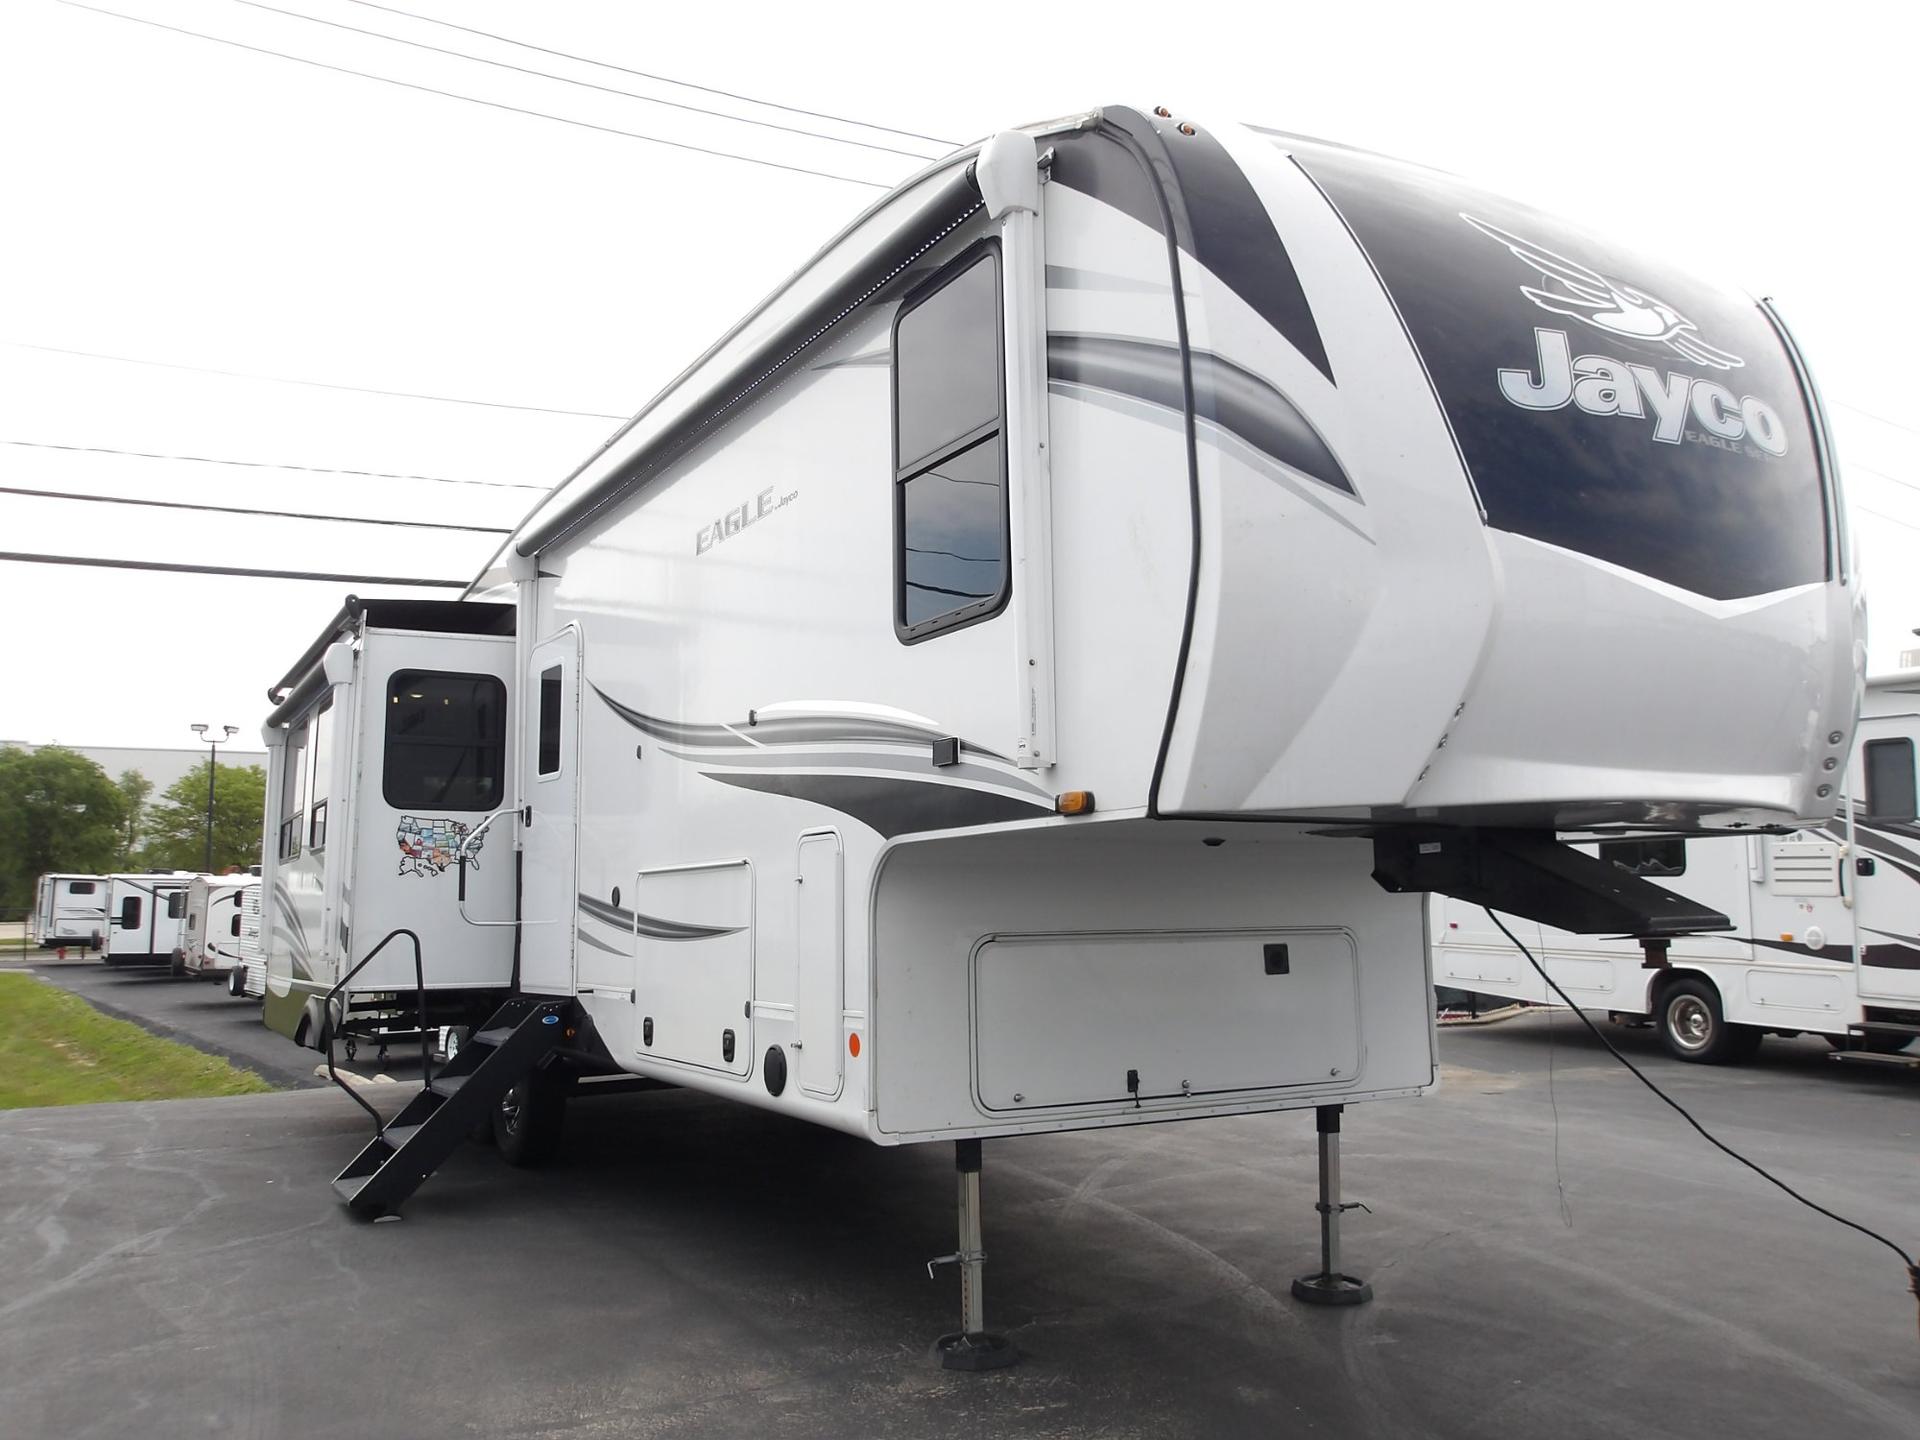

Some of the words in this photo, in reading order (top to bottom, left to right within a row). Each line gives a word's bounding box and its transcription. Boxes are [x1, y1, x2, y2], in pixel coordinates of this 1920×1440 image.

[1498, 327, 1788, 457] Jayco
[1684, 429, 1742, 454] EAGLE
[696, 485, 774, 556] EAGLE
